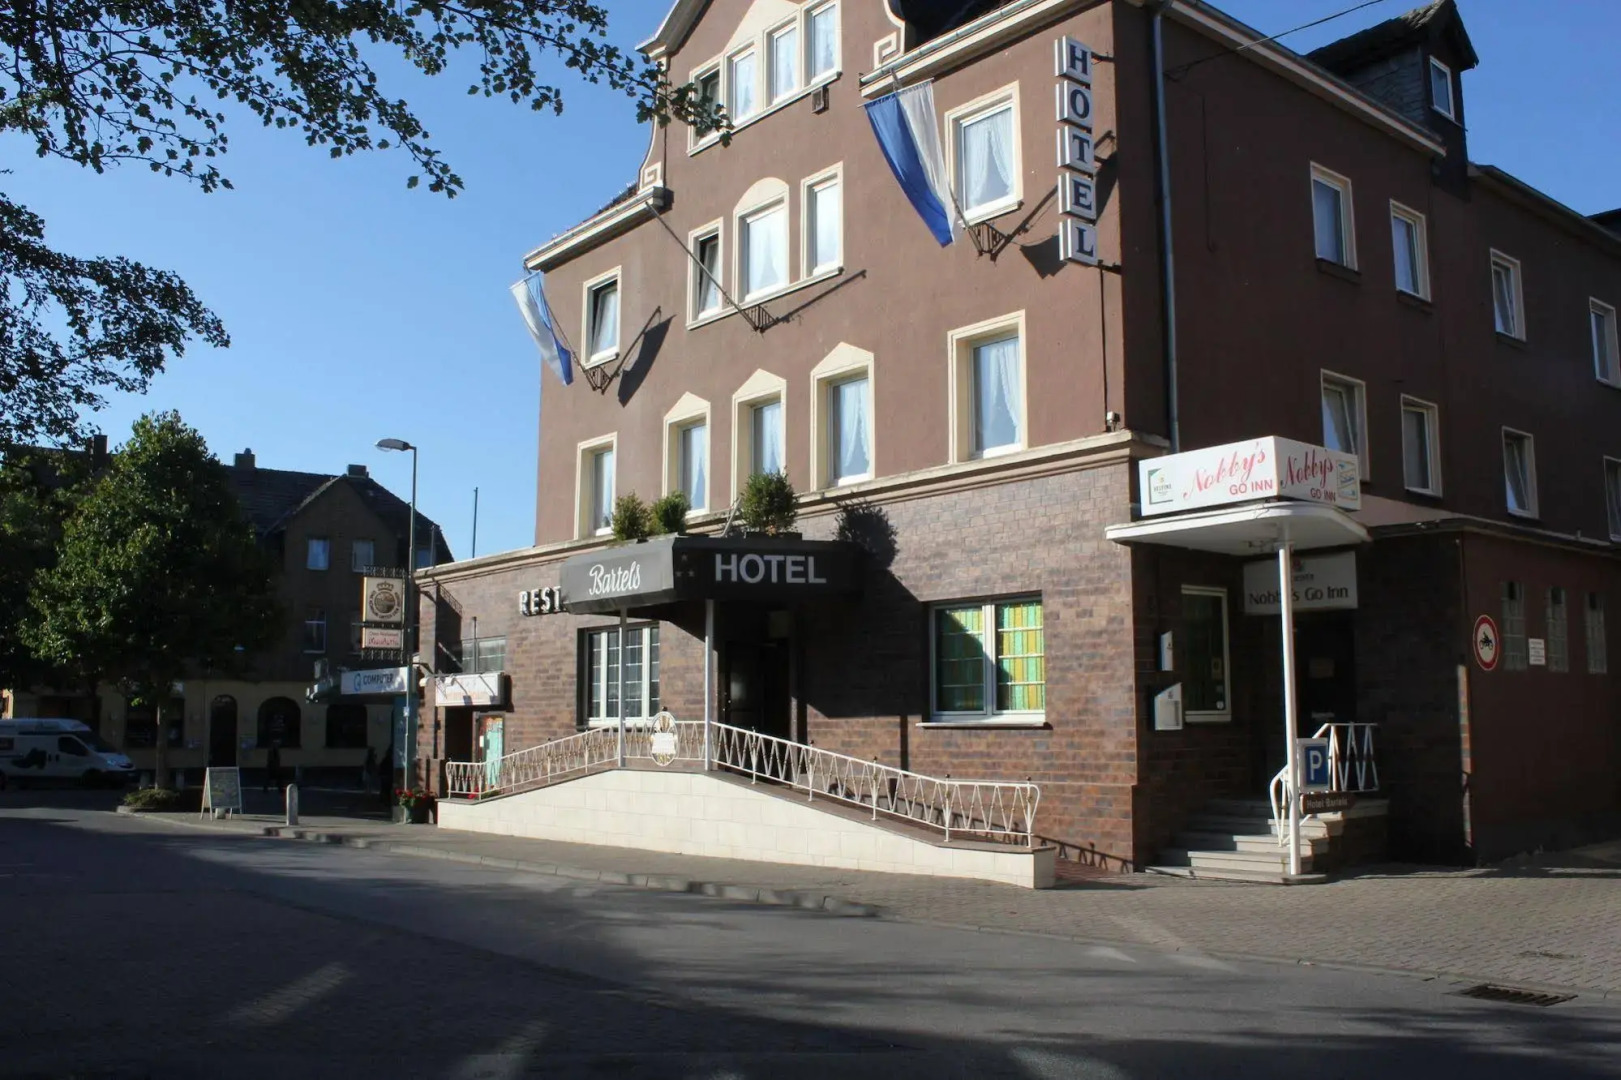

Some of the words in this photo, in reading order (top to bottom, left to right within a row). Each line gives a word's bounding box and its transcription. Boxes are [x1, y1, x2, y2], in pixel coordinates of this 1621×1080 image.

[1068, 44, 1095, 258] HOTEL
[1183, 441, 1266, 499] Nobby's
[1280, 448, 1334, 489] Nobby's
[1229, 483, 1248, 496] GO
[1251, 479, 1273, 492] INN
[1310, 487, 1322, 499] GO
[1323, 490, 1336, 502] INN
[588, 560, 641, 596] Bartels
[715, 553, 827, 584] HOTEL
[1304, 587, 1323, 601] Go
[1326, 586, 1349, 600] Inn
[362, 673, 394, 686] COMPUTER
[1309, 750, 1323, 780] P
